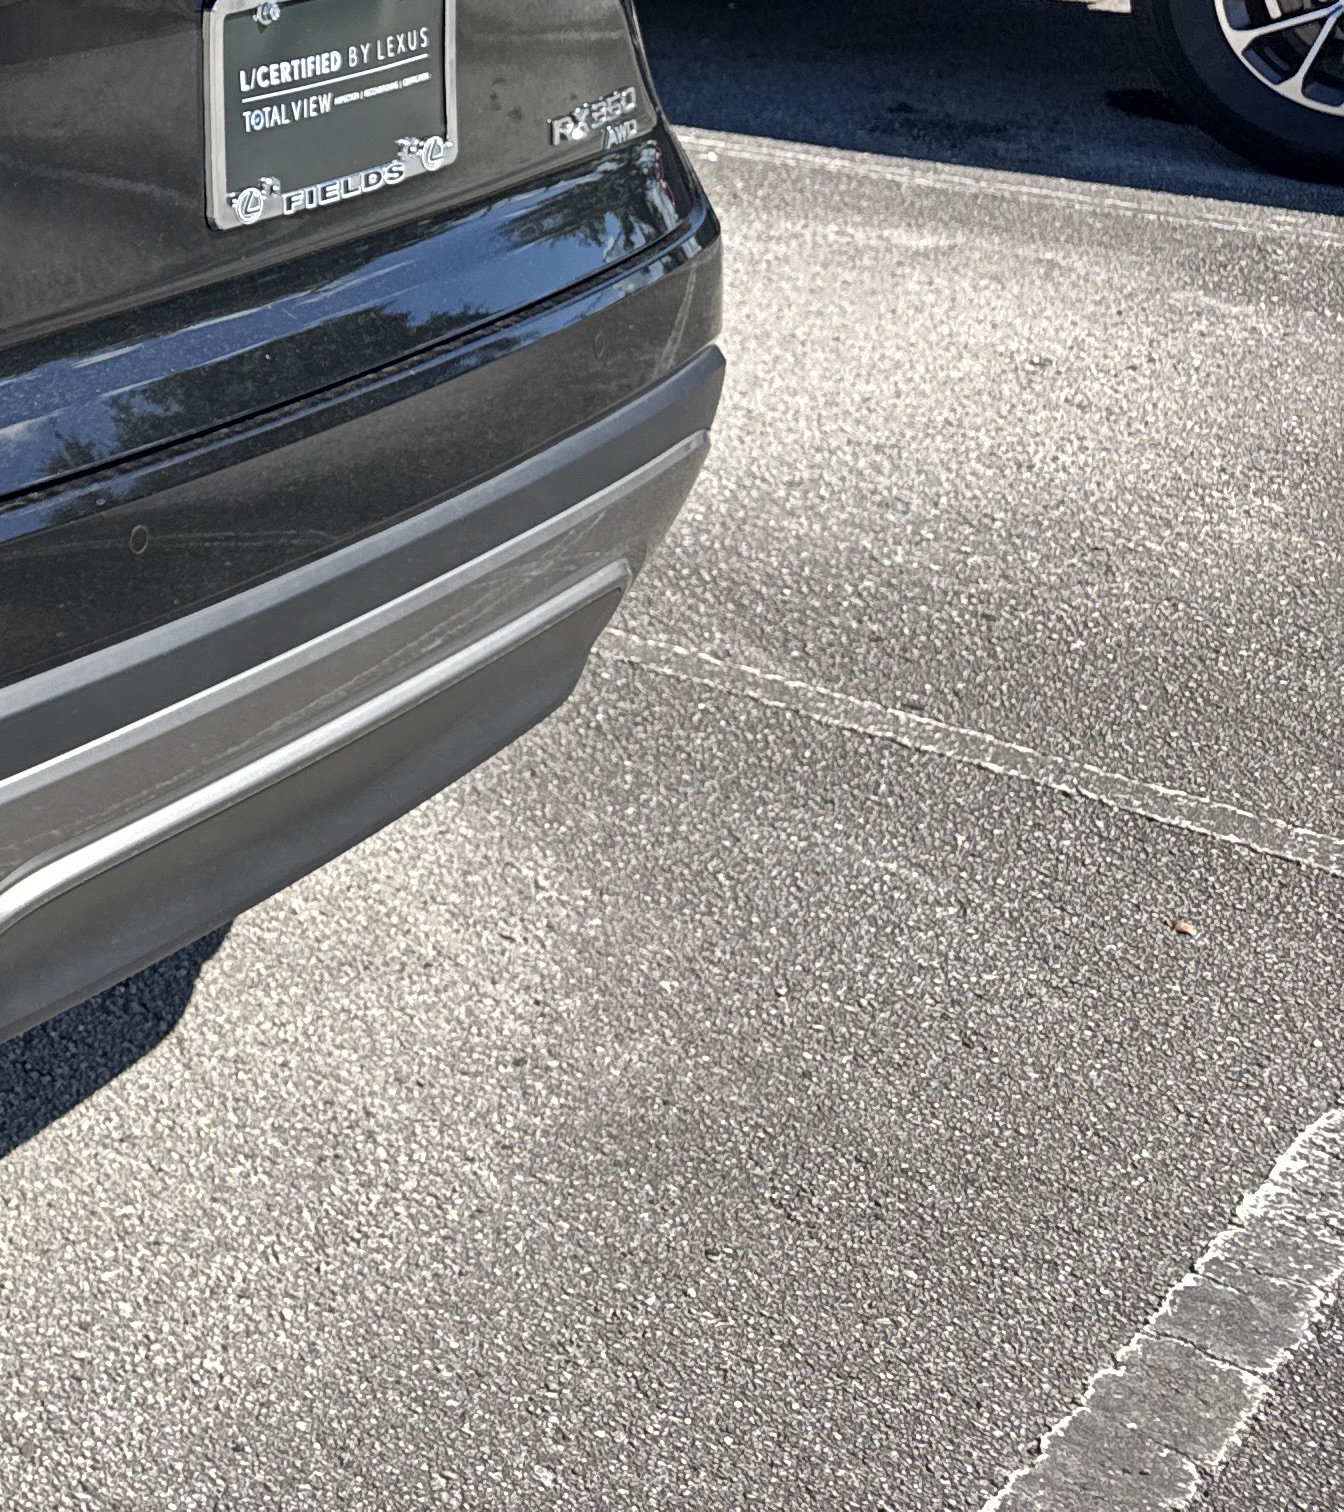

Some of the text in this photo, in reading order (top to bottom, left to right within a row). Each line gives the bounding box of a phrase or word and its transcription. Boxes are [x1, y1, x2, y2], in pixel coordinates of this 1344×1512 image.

[240, 50, 342, 92] L/CERTIFIED
[348, 42, 371, 68] BY
[376, 26, 430, 61] LEXUS
[242, 91, 333, 133] TOTAL VIEW
[603, 118, 638, 150] AWD
[282, 161, 405, 215] FIELDS
